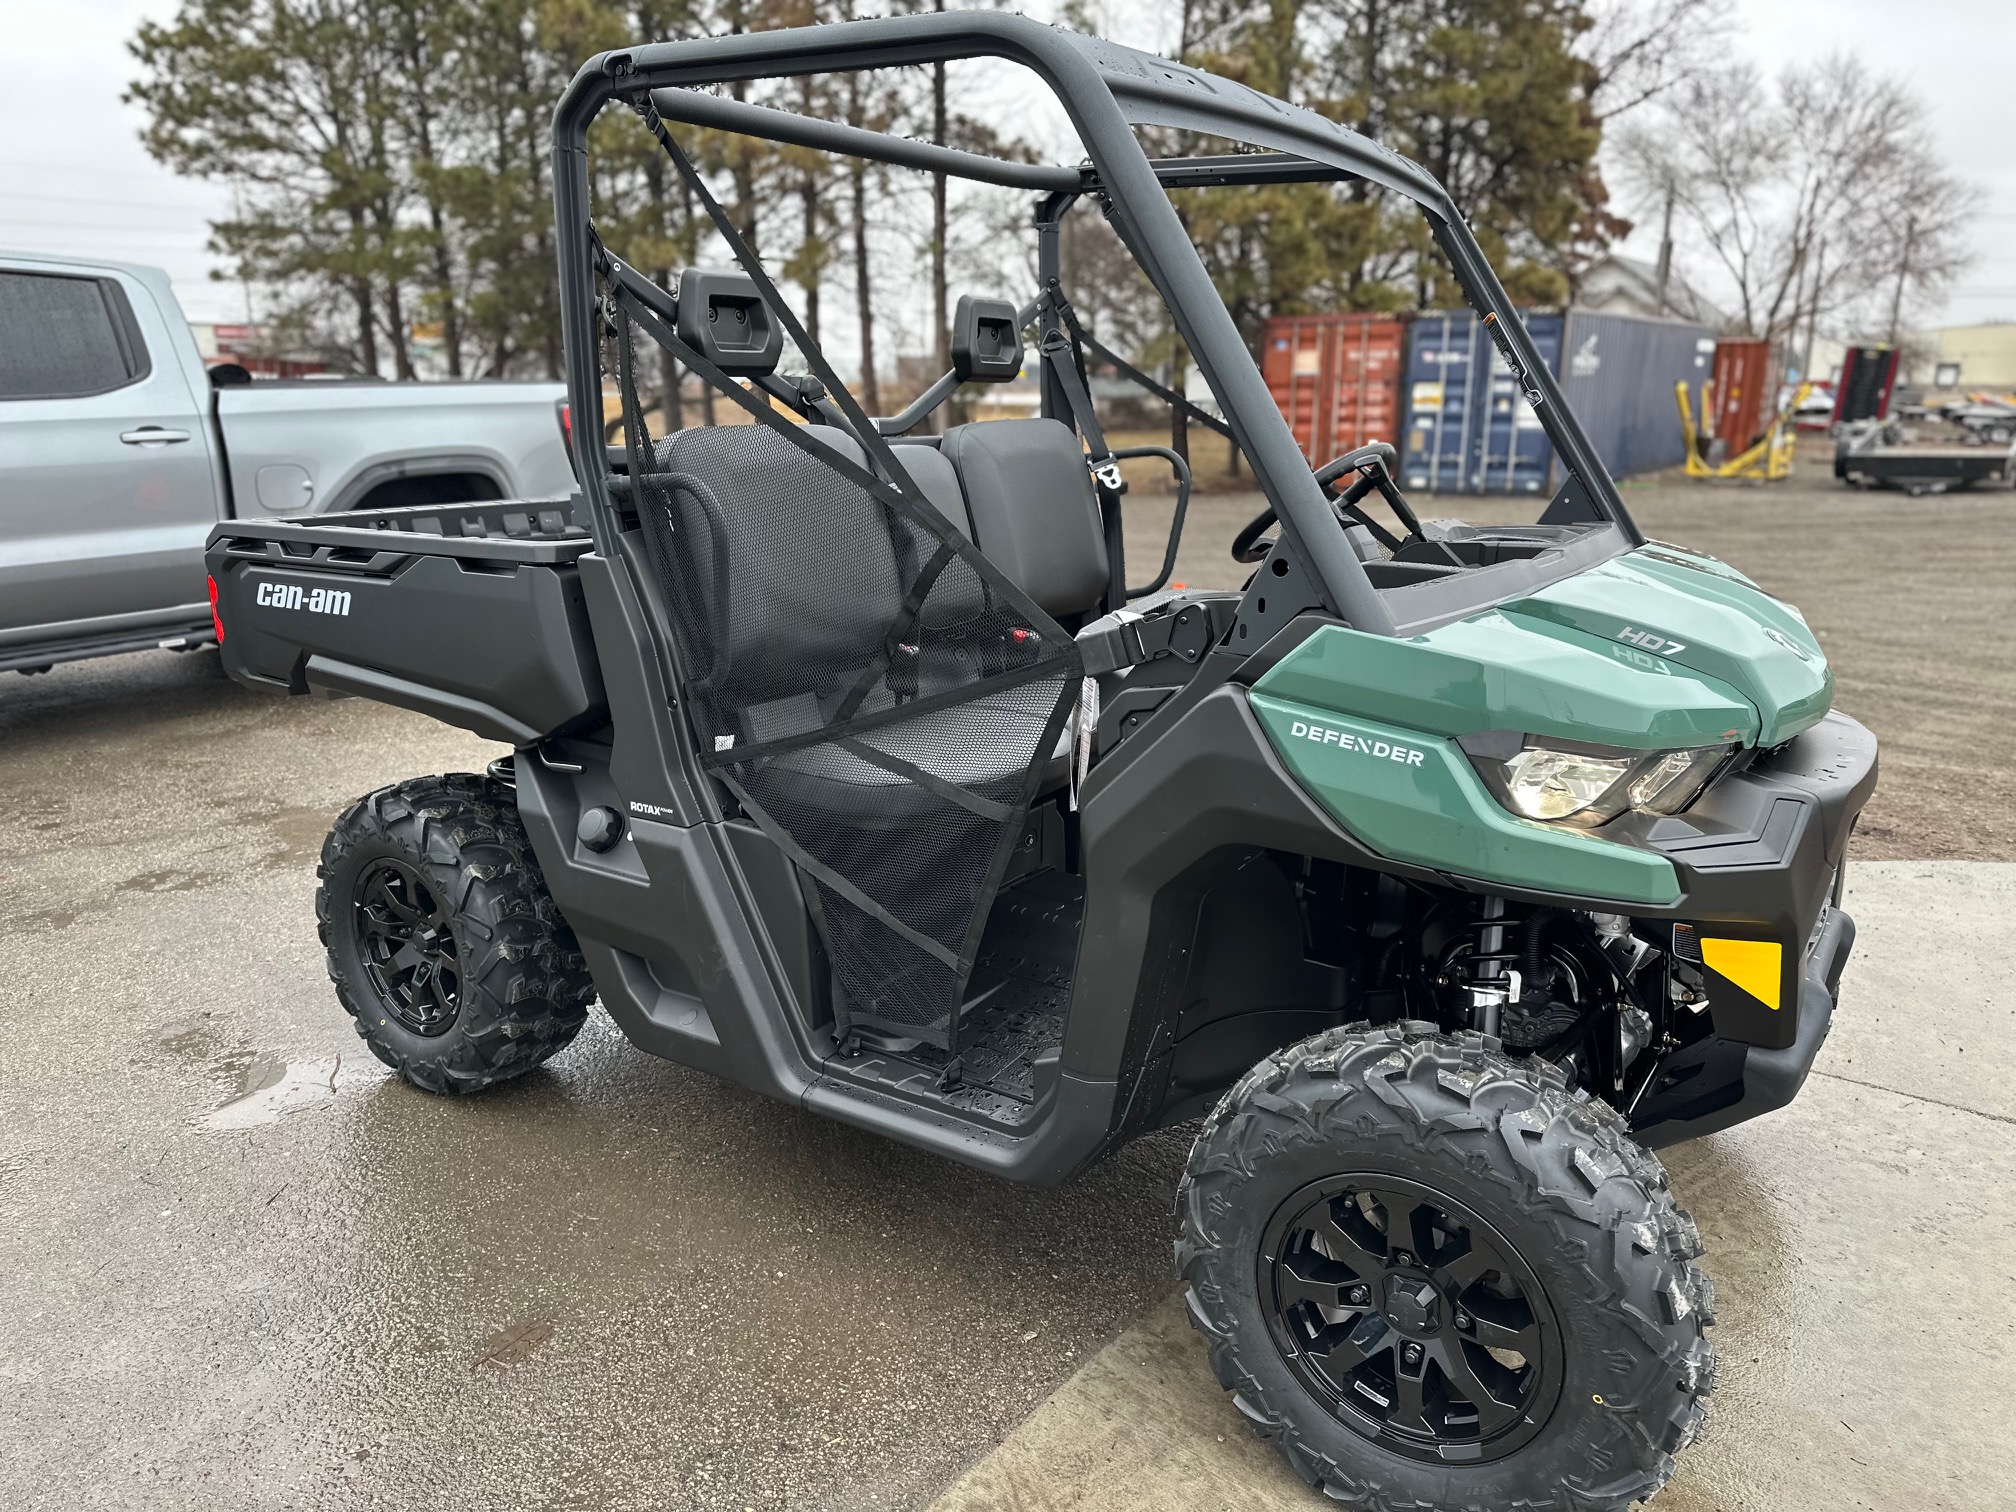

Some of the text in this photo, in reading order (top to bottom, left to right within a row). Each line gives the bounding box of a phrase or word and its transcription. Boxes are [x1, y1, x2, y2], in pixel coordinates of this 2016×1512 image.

[257, 582, 352, 616] can-am
[1616, 626, 1686, 656] HD7
[1291, 721, 1425, 767] DEFENDER
[630, 801, 661, 816] ROTAX
